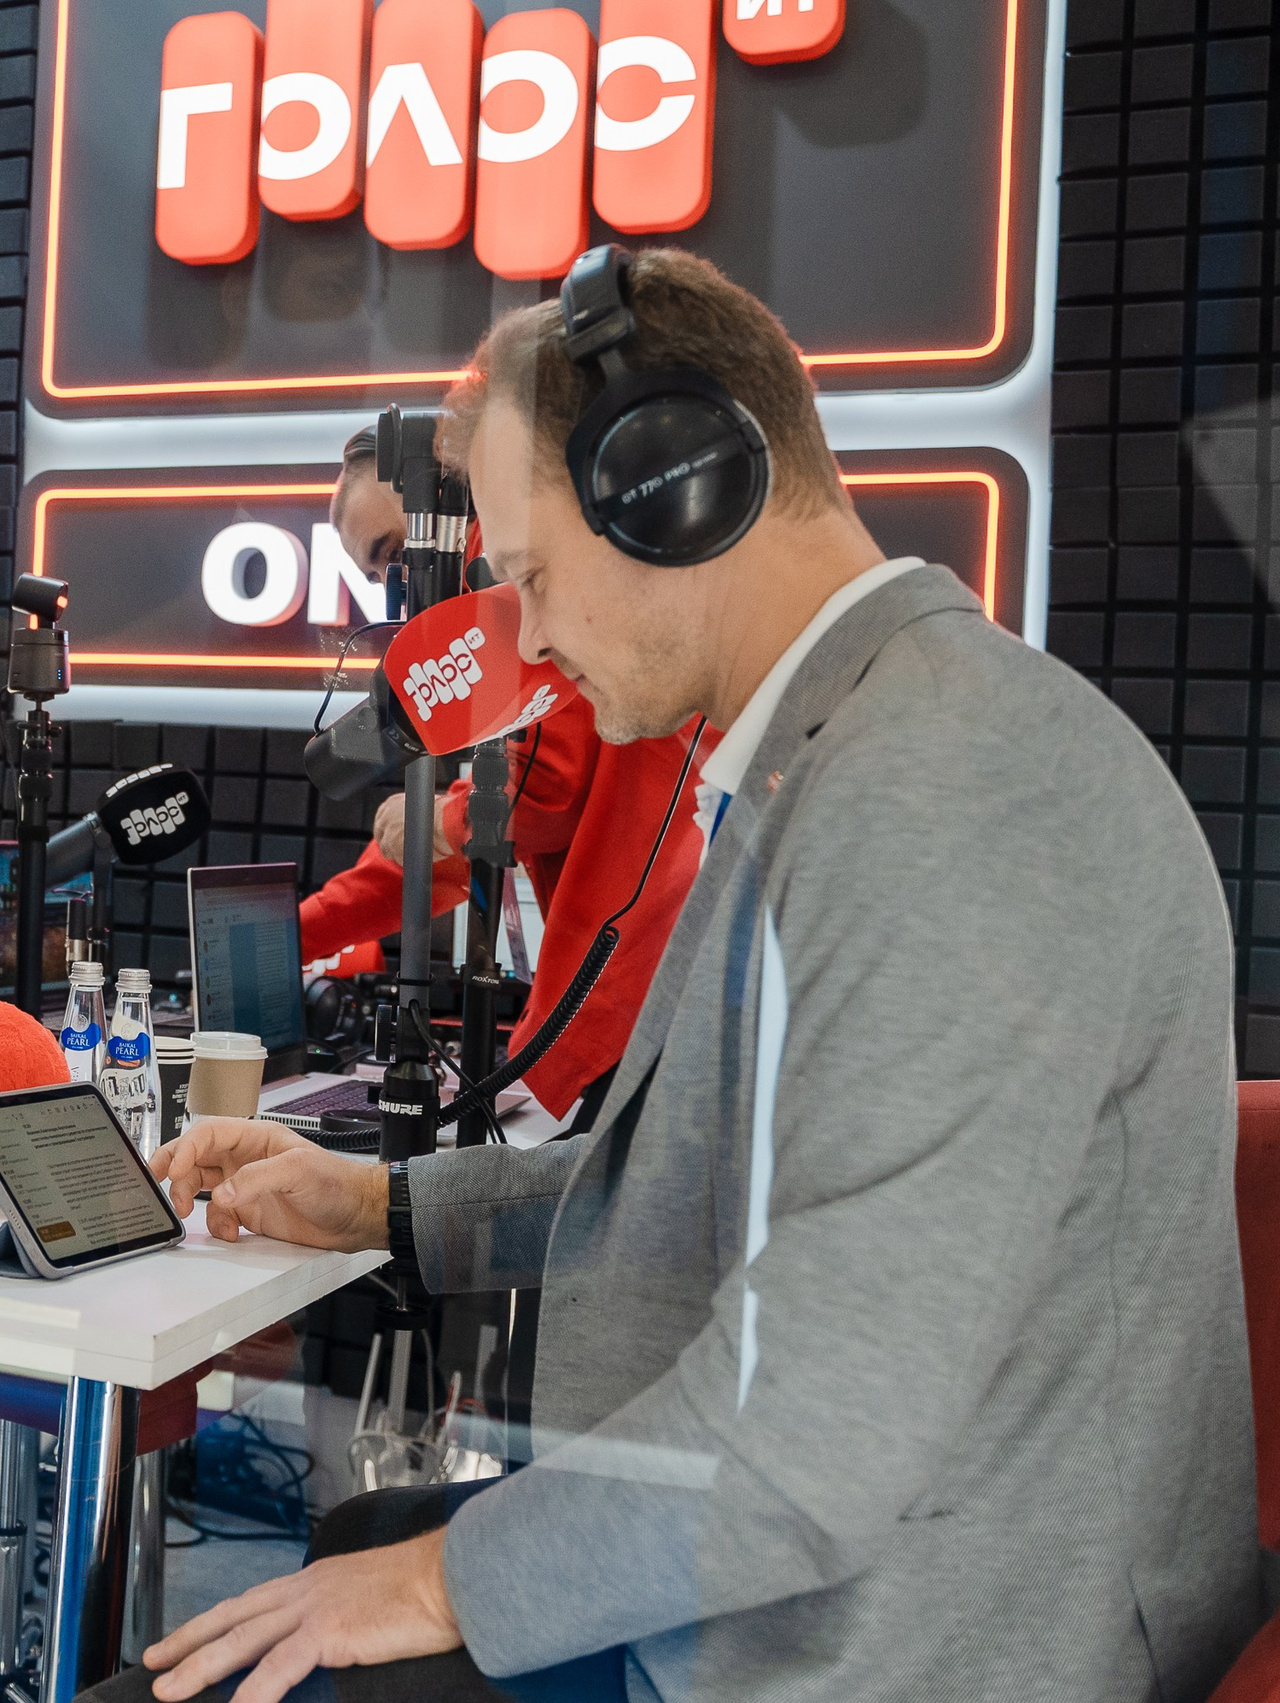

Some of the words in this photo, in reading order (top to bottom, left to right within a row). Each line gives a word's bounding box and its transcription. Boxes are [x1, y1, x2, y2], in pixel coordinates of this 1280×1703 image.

[157, 36, 696, 189] ГОЛОС
[638, 476, 663, 497] 770
[663, 462, 691, 481] PRO
[406, 648, 474, 713] ГОЛОС
[122, 803, 181, 840] ГОЛОС
[66, 1038, 90, 1047] PEARL
[115, 1047, 140, 1056] PEARL
[378, 1099, 423, 1116] SHURE
